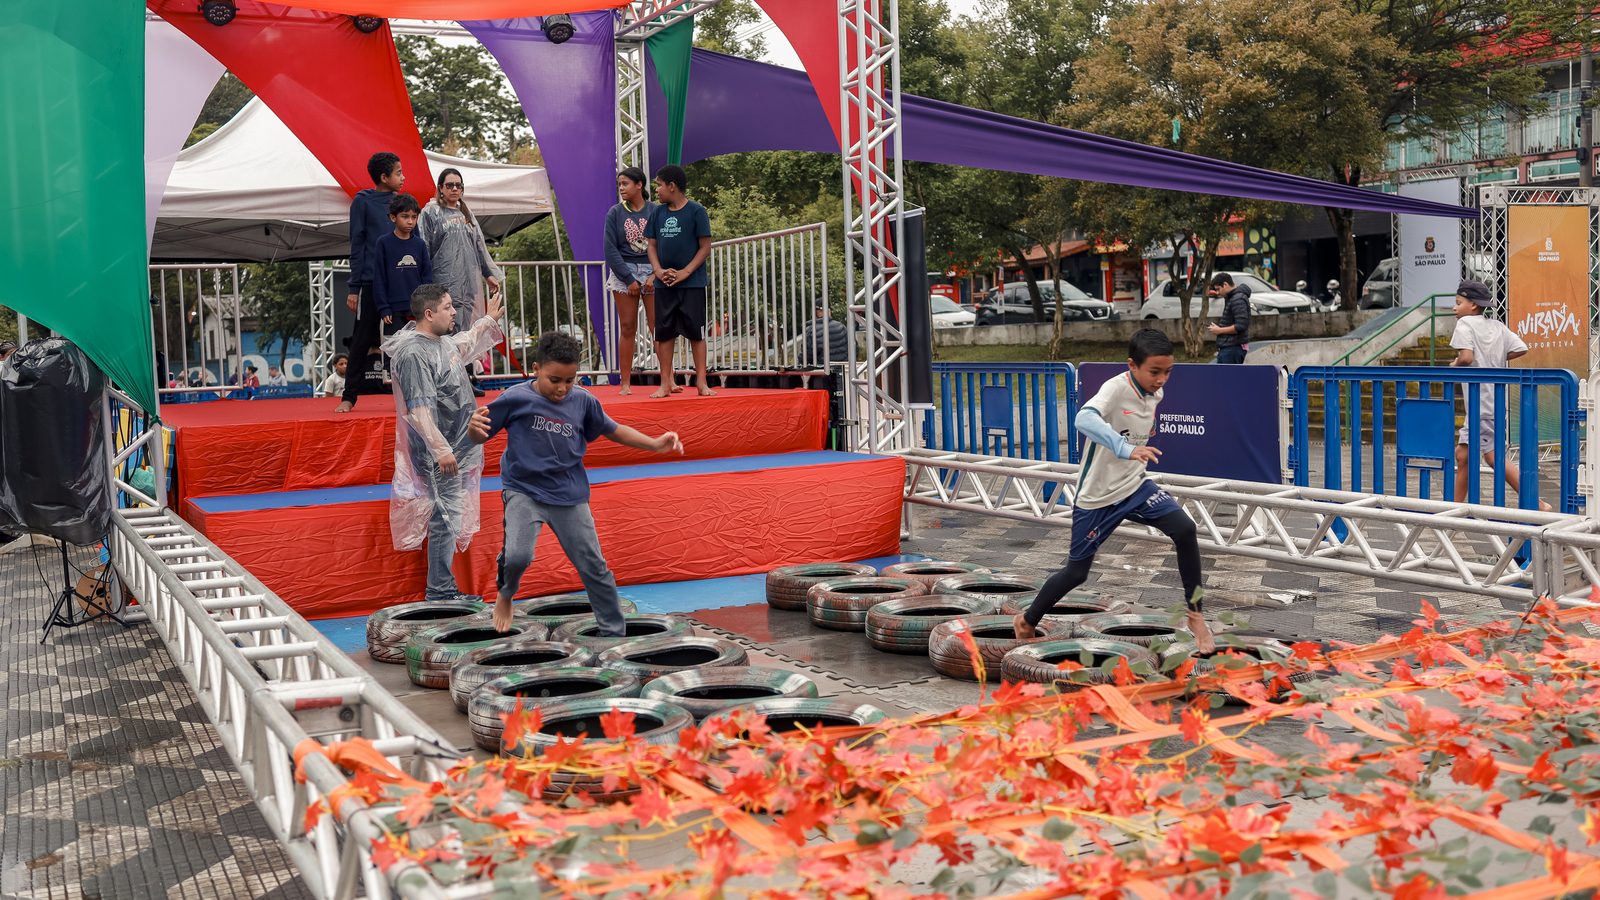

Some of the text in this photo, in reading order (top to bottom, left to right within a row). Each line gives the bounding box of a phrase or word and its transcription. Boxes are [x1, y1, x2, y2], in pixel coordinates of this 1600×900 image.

[1415, 259, 1426, 267] SÃO
[1160, 414, 1204, 423] PREFEITURA DE
[1160, 421, 1205, 435] SÃO PAULO
